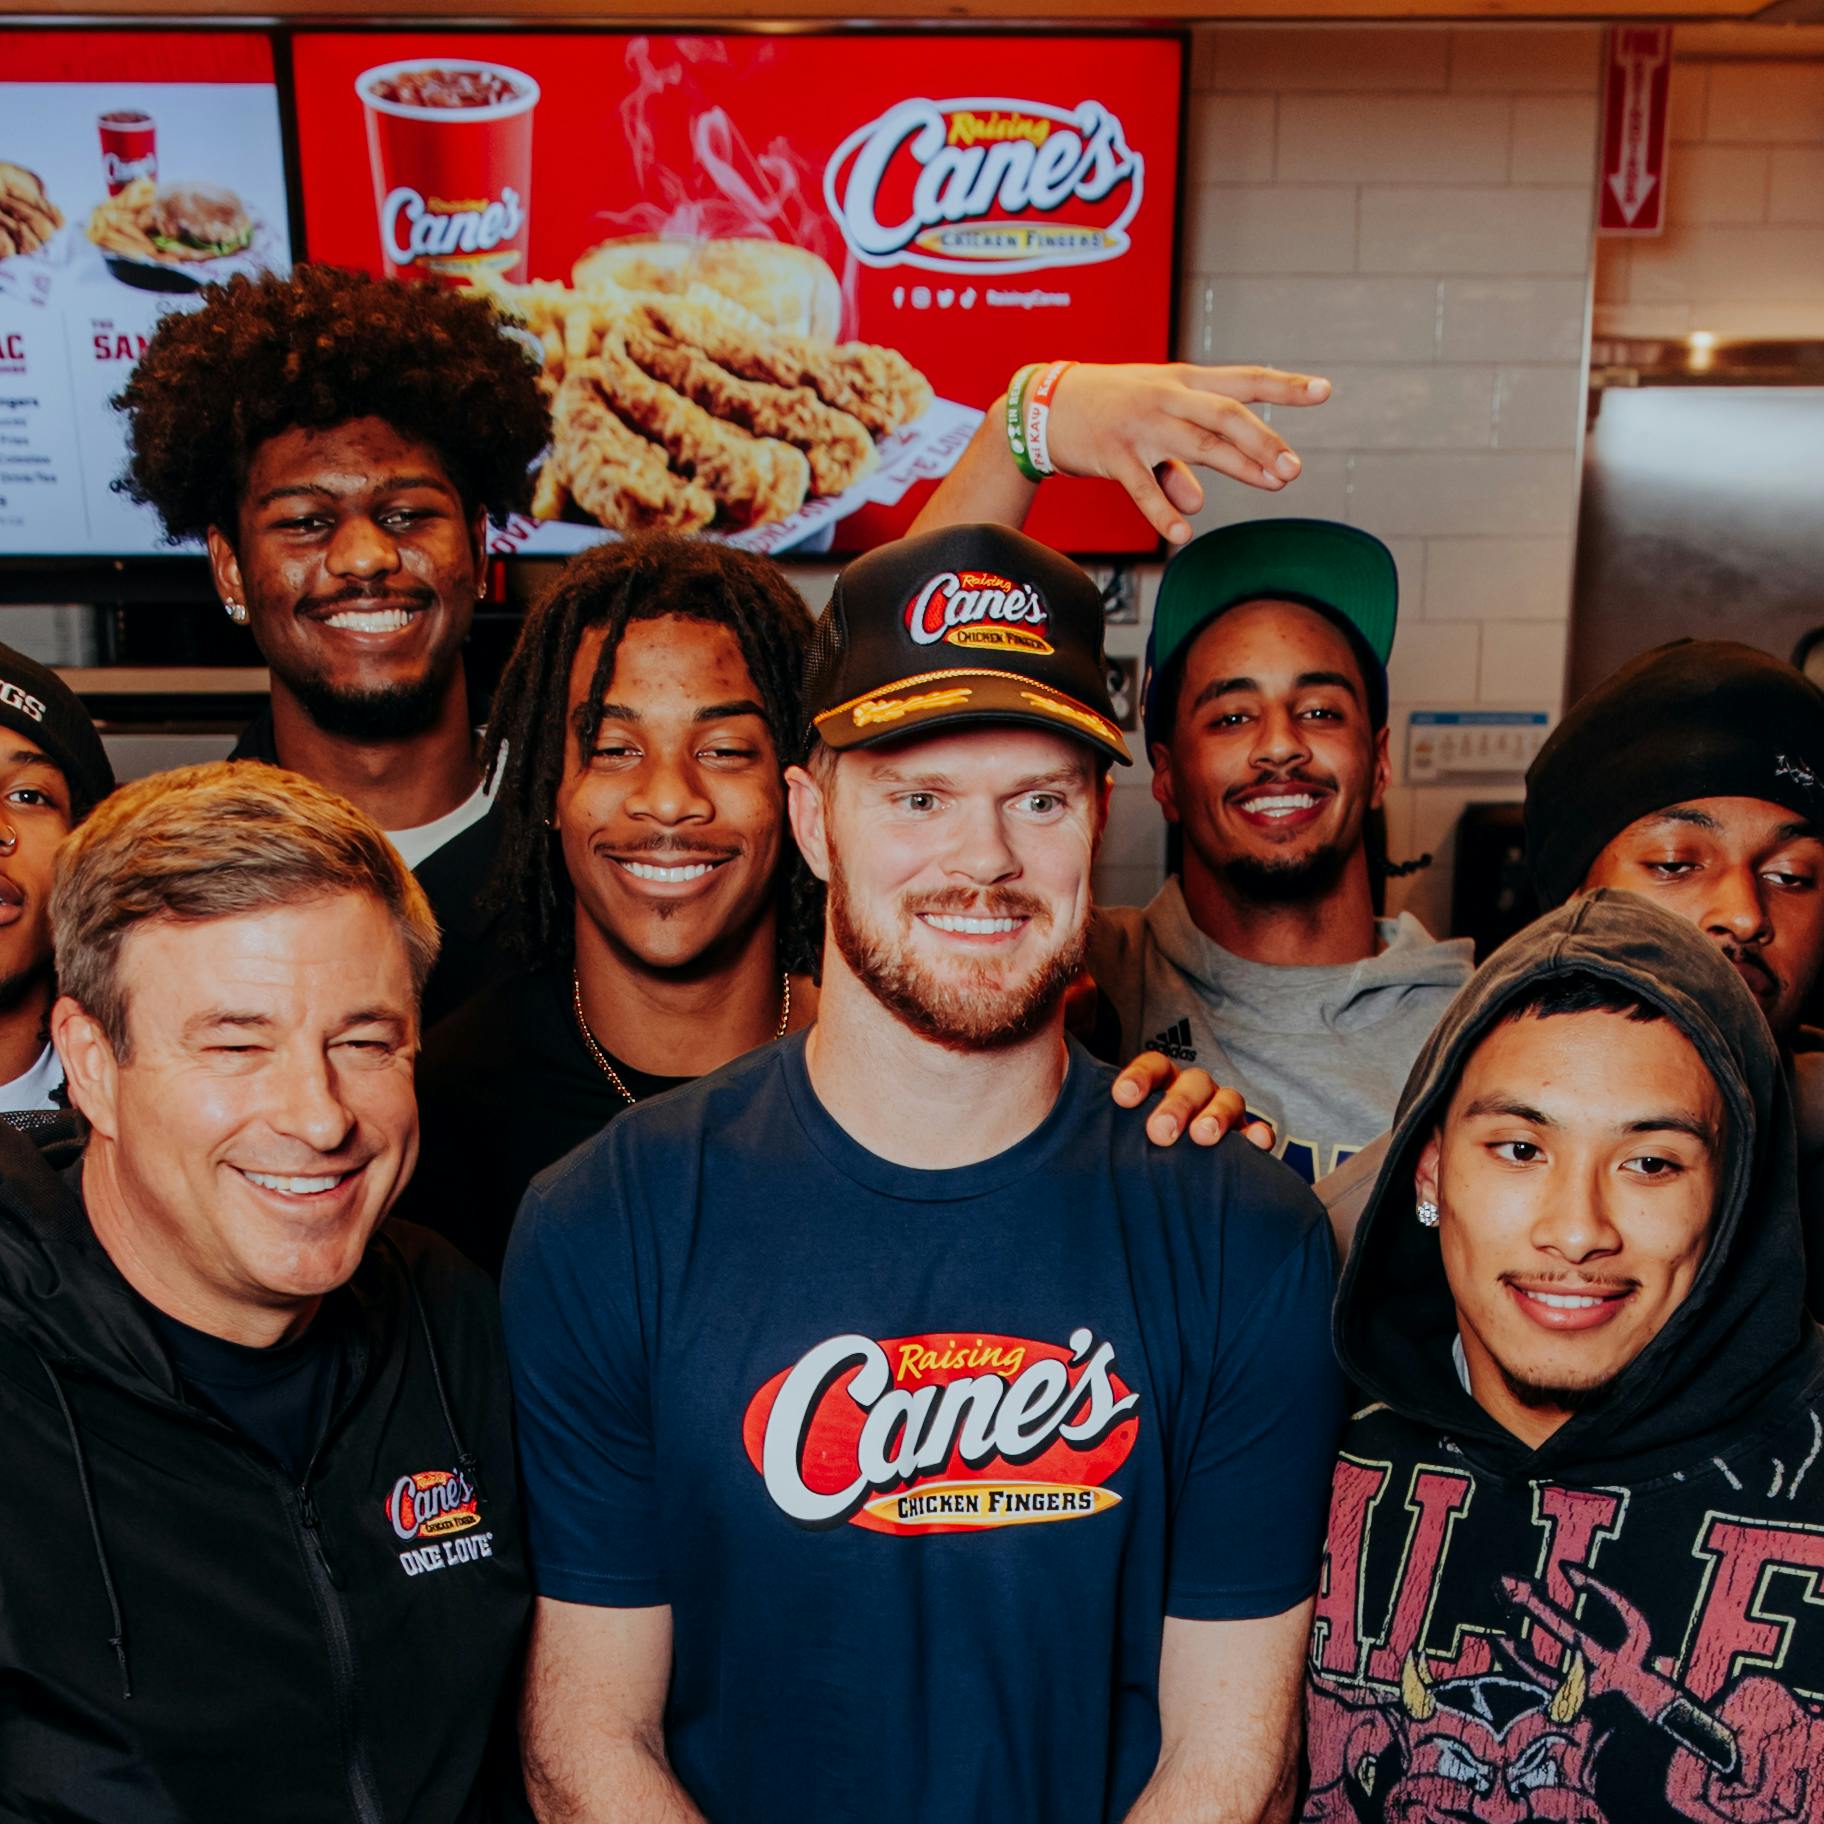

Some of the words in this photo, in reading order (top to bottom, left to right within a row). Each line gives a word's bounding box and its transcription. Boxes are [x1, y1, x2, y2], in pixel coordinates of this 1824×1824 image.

[948, 112, 1051, 147] Raising
[844, 98, 1133, 256] Cane's
[961, 574, 1013, 593] Raising
[909, 572, 1047, 647] Cane's
[896, 1339, 1027, 1382] Raising
[762, 1327, 1140, 1521] Cane's
[391, 1467, 474, 1540] Cane's
[897, 1493, 981, 1520] CHICKEN
[988, 1489, 1092, 1513] FINGERS
[399, 1545, 445, 1577] ONE
[442, 1533, 493, 1567] LOVE
